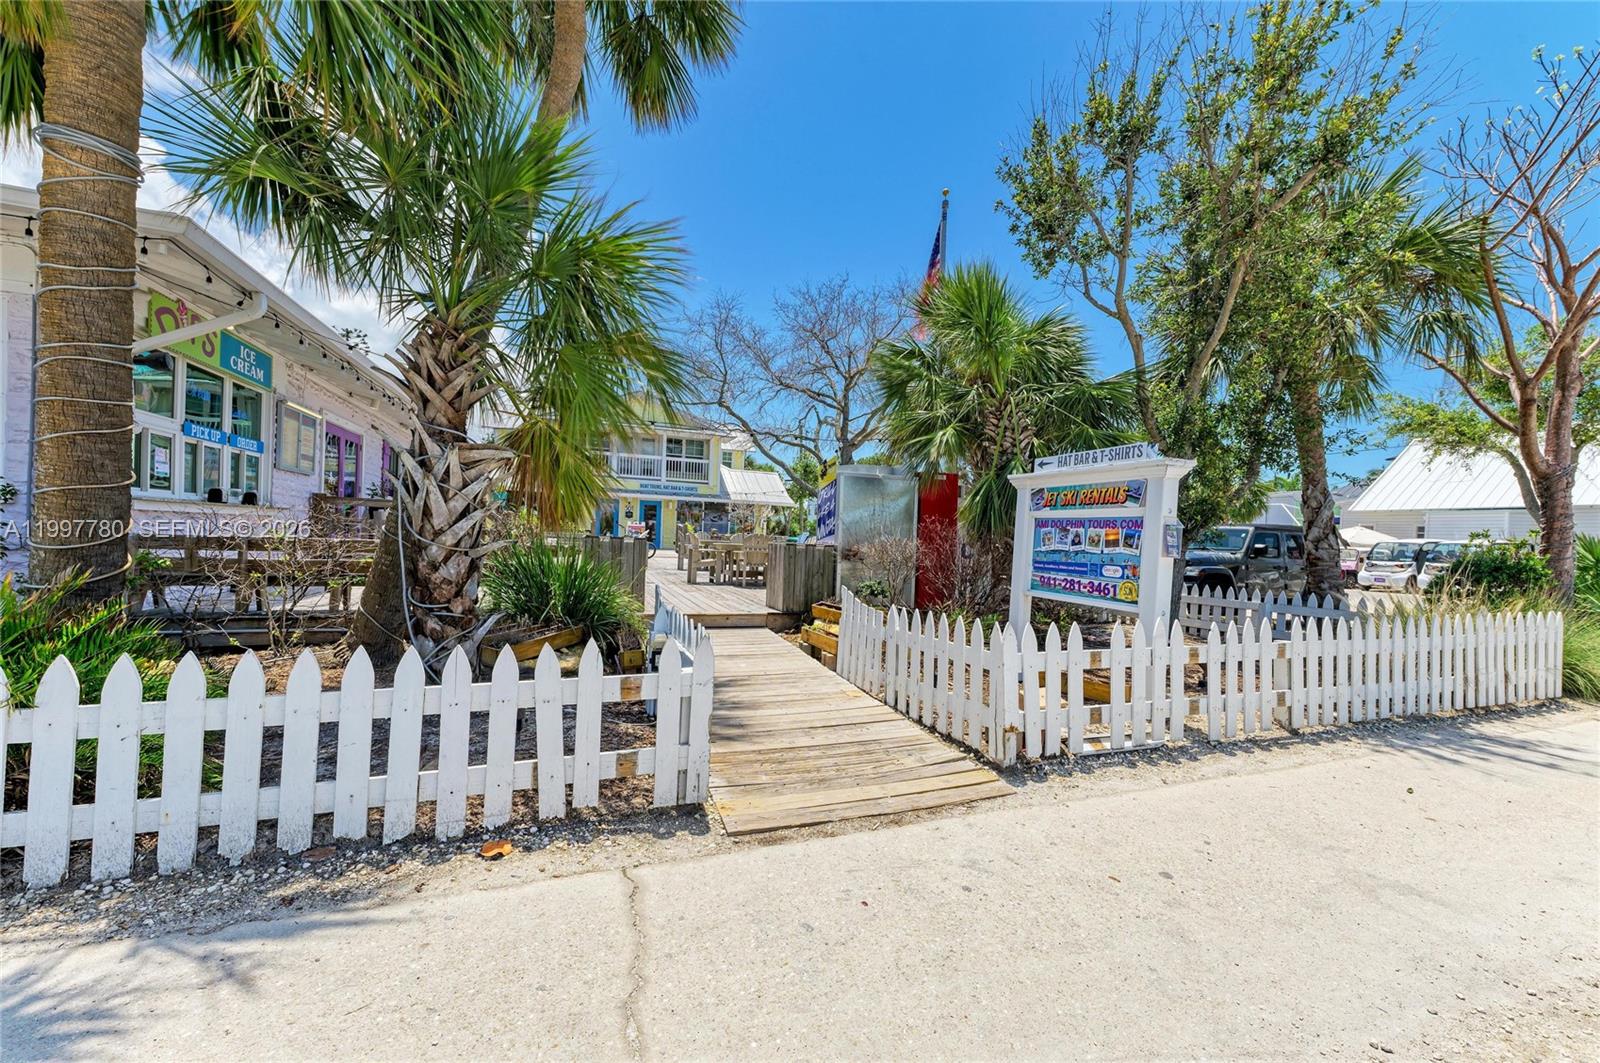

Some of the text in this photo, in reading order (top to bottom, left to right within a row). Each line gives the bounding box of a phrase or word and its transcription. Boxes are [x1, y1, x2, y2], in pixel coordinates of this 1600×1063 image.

[240, 345, 256, 364] ICE
[230, 355, 264, 382] CREAM
[191, 425, 221, 442] PICK UP
[237, 437, 258, 451] ORDER
[1057, 444, 1144, 468] HAT BAR & T-SHIRTS
[1042, 486, 1129, 508] JET SKI RENTALS
[1036, 520, 1049, 529] AMI
[1050, 519, 1085, 529] DOLPHIN
[1039, 575, 1118, 597] 941-281-3461
